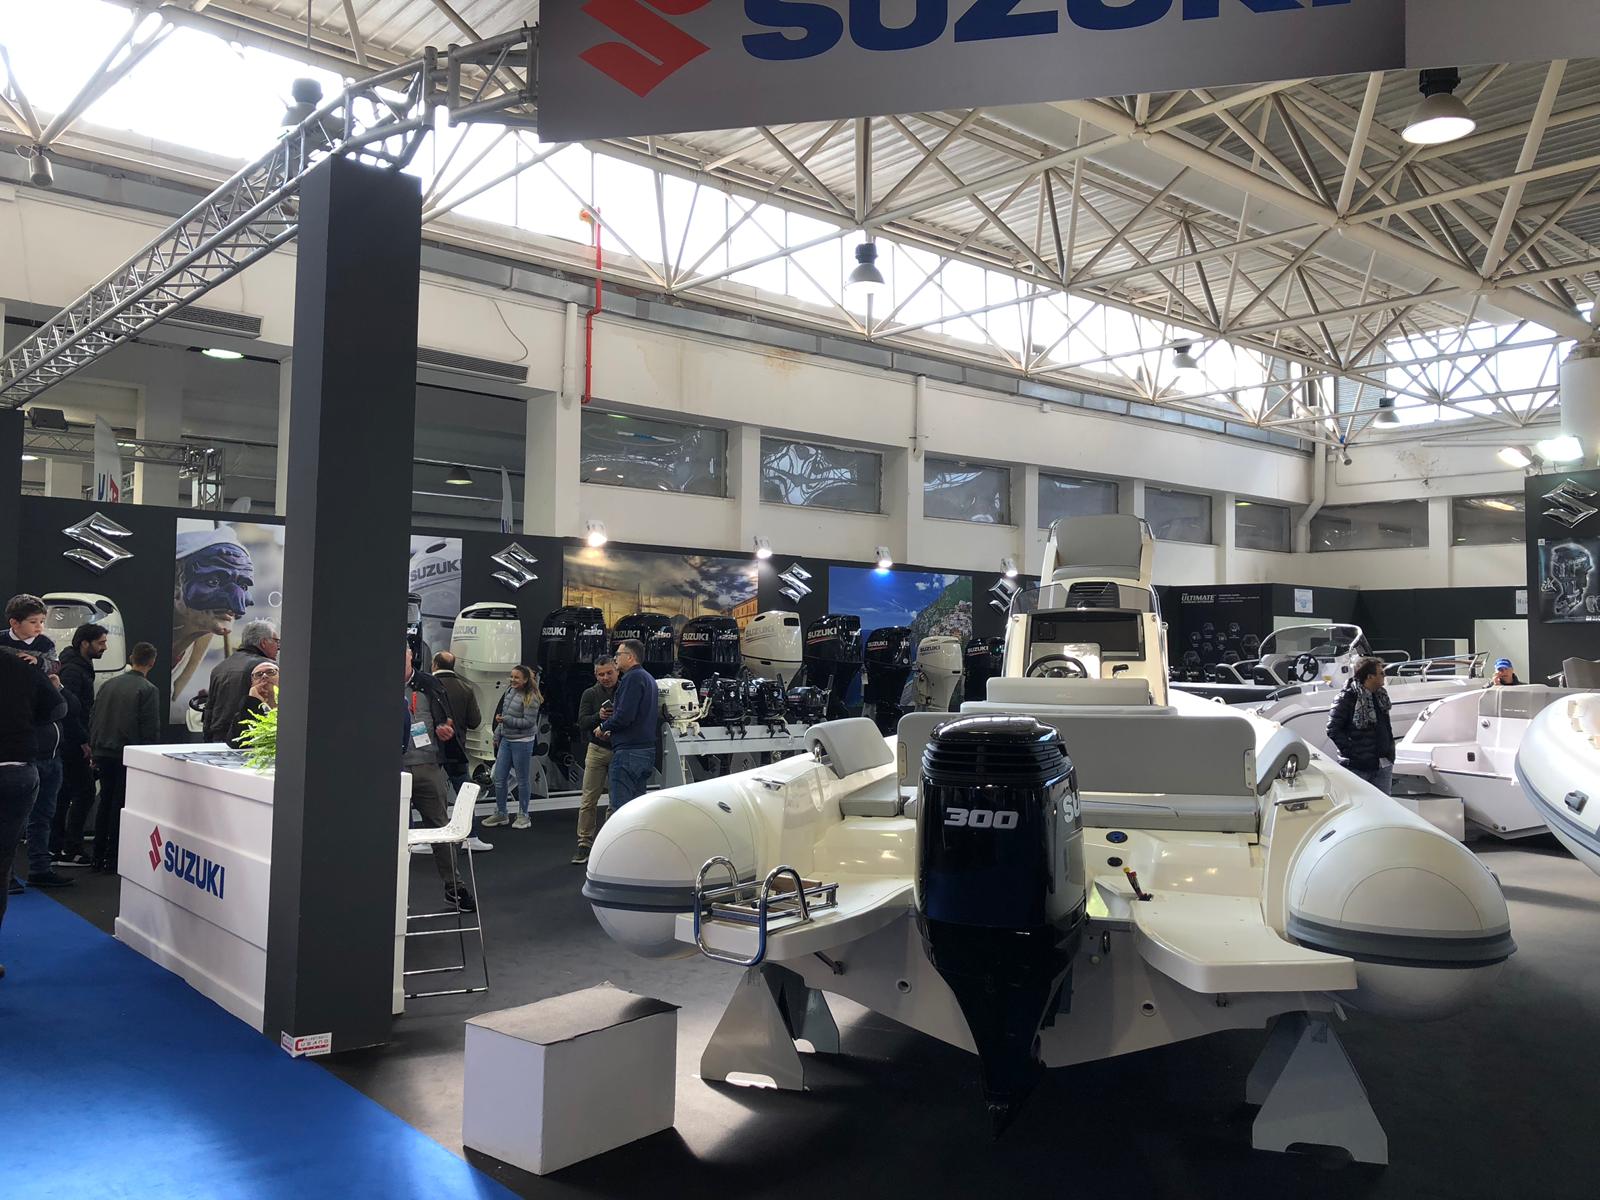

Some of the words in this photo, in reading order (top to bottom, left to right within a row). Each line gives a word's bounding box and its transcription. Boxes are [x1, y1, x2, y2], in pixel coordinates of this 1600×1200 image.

[410, 559, 462, 581] SUZUK
[542, 627, 567, 636] SUZUKI
[614, 630, 640, 639] SUZUKI
[682, 632, 709, 641] SUZUKI
[807, 627, 838, 639] SUZUKI
[967, 645, 989, 653] SUZUKI
[944, 807, 1019, 829] 300
[164, 840, 225, 900] SUZUKI
